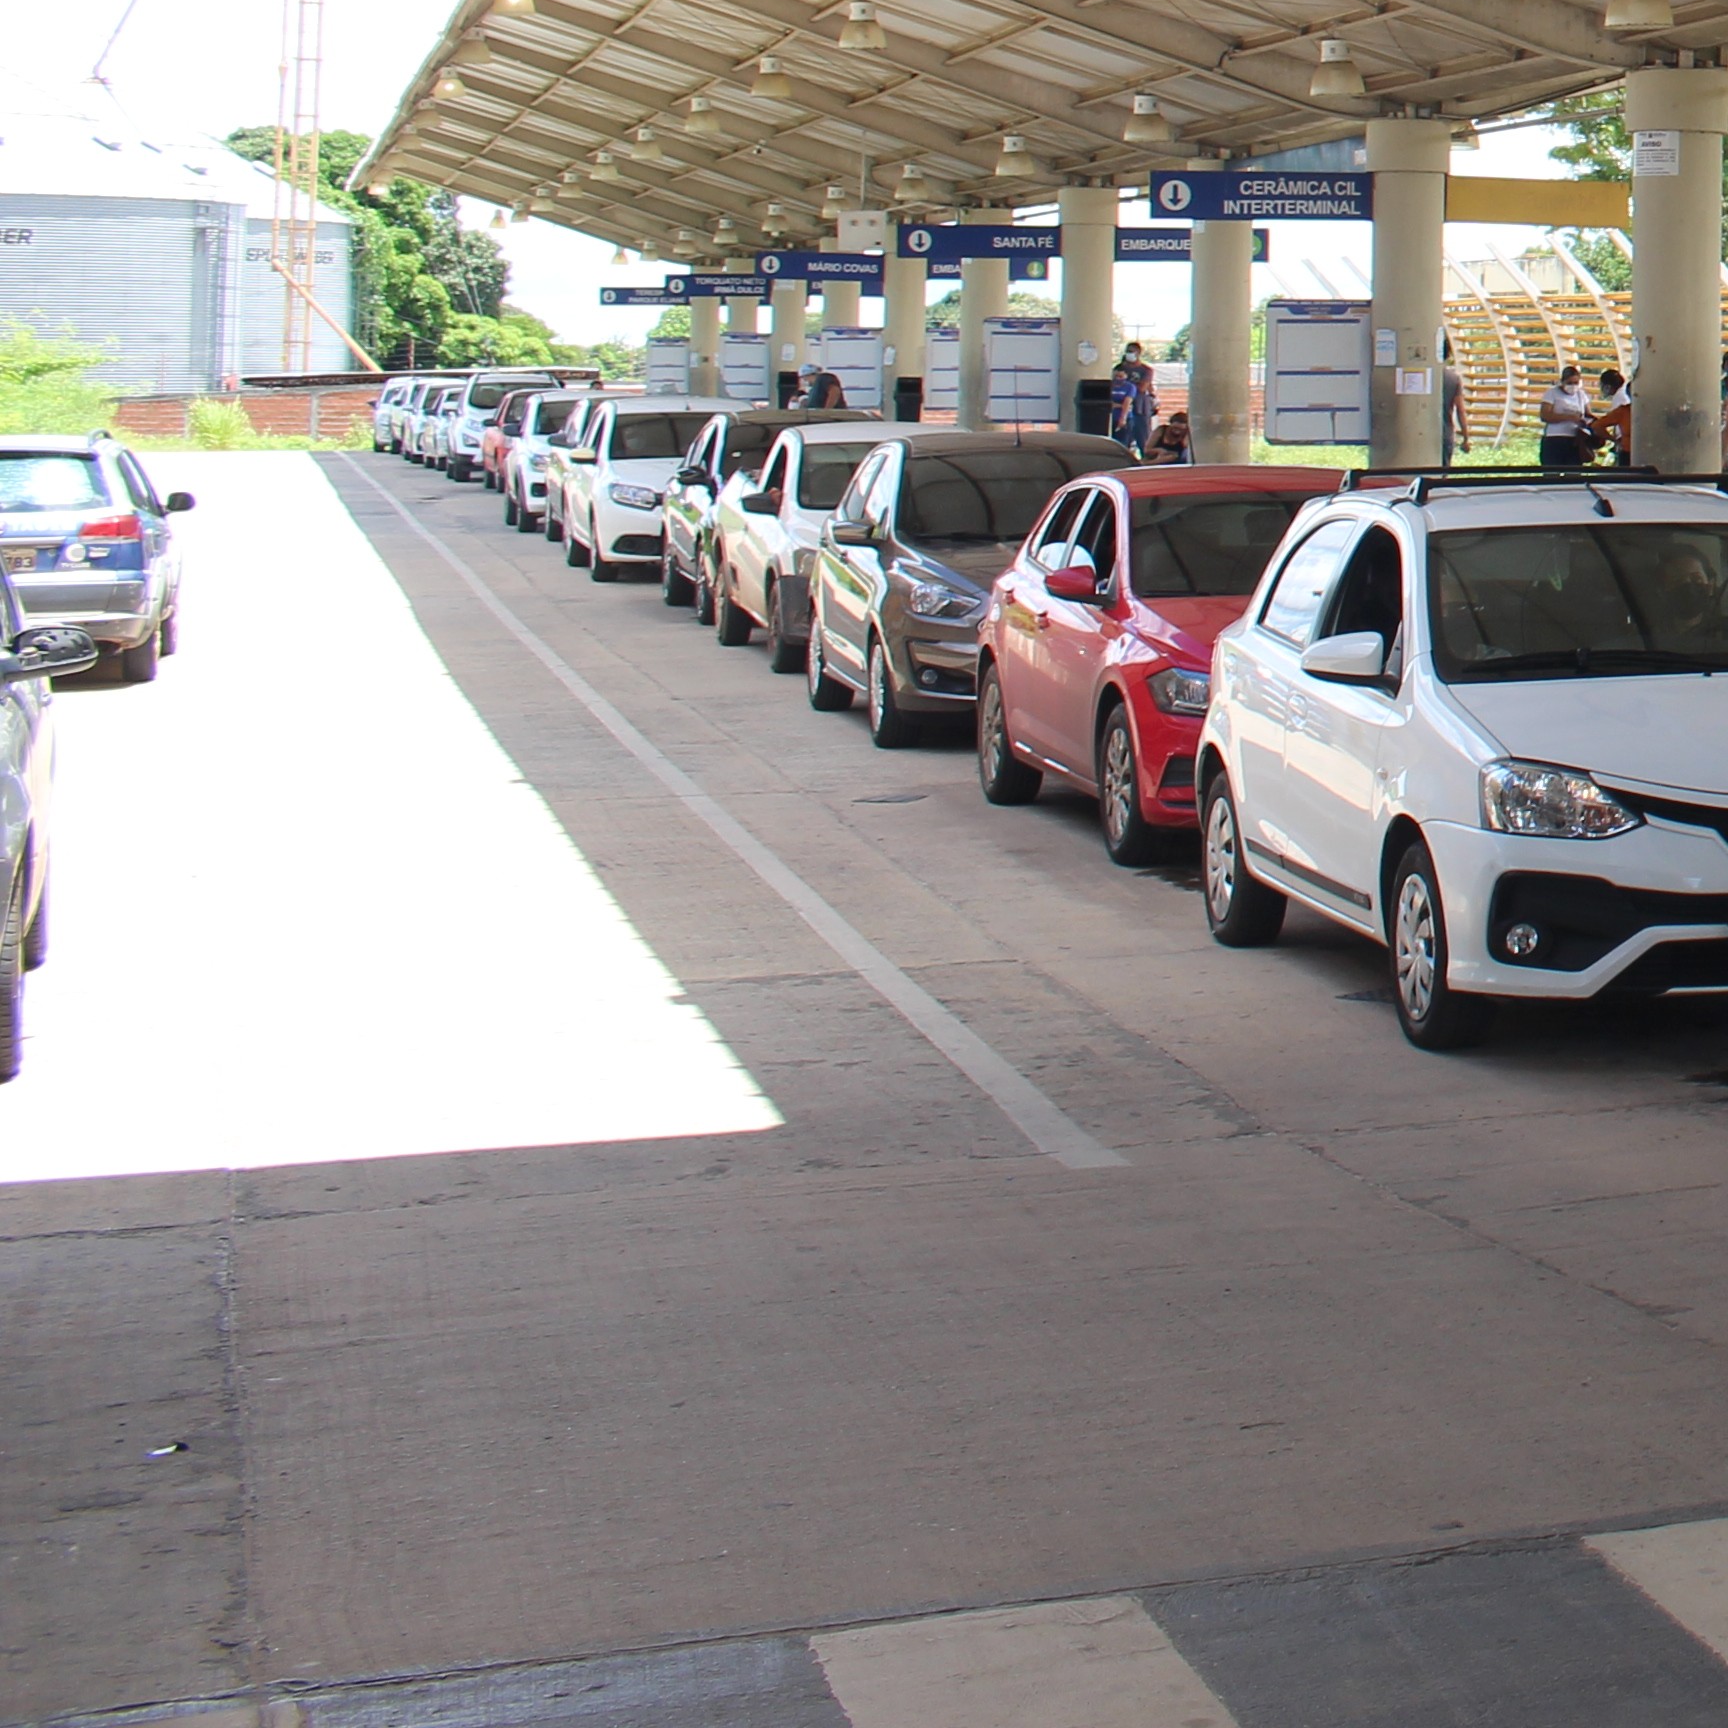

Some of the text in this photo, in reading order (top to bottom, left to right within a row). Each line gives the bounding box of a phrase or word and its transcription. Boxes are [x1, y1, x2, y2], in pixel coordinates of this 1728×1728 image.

[1239, 177, 1361, 196] CERÂMICA CIL
[1223, 200, 1361, 215] INTERTERMINAL
[993, 234, 1054, 249] SANTA FÉ
[1121, 238, 1192, 251] EMBARQUE
[807, 261, 879, 274] MÁRIO COVAS
[932, 265, 961, 274] EMBA
[695, 277, 766, 286] TORQUATO NETO
[737, 286, 765, 294] DULCE
